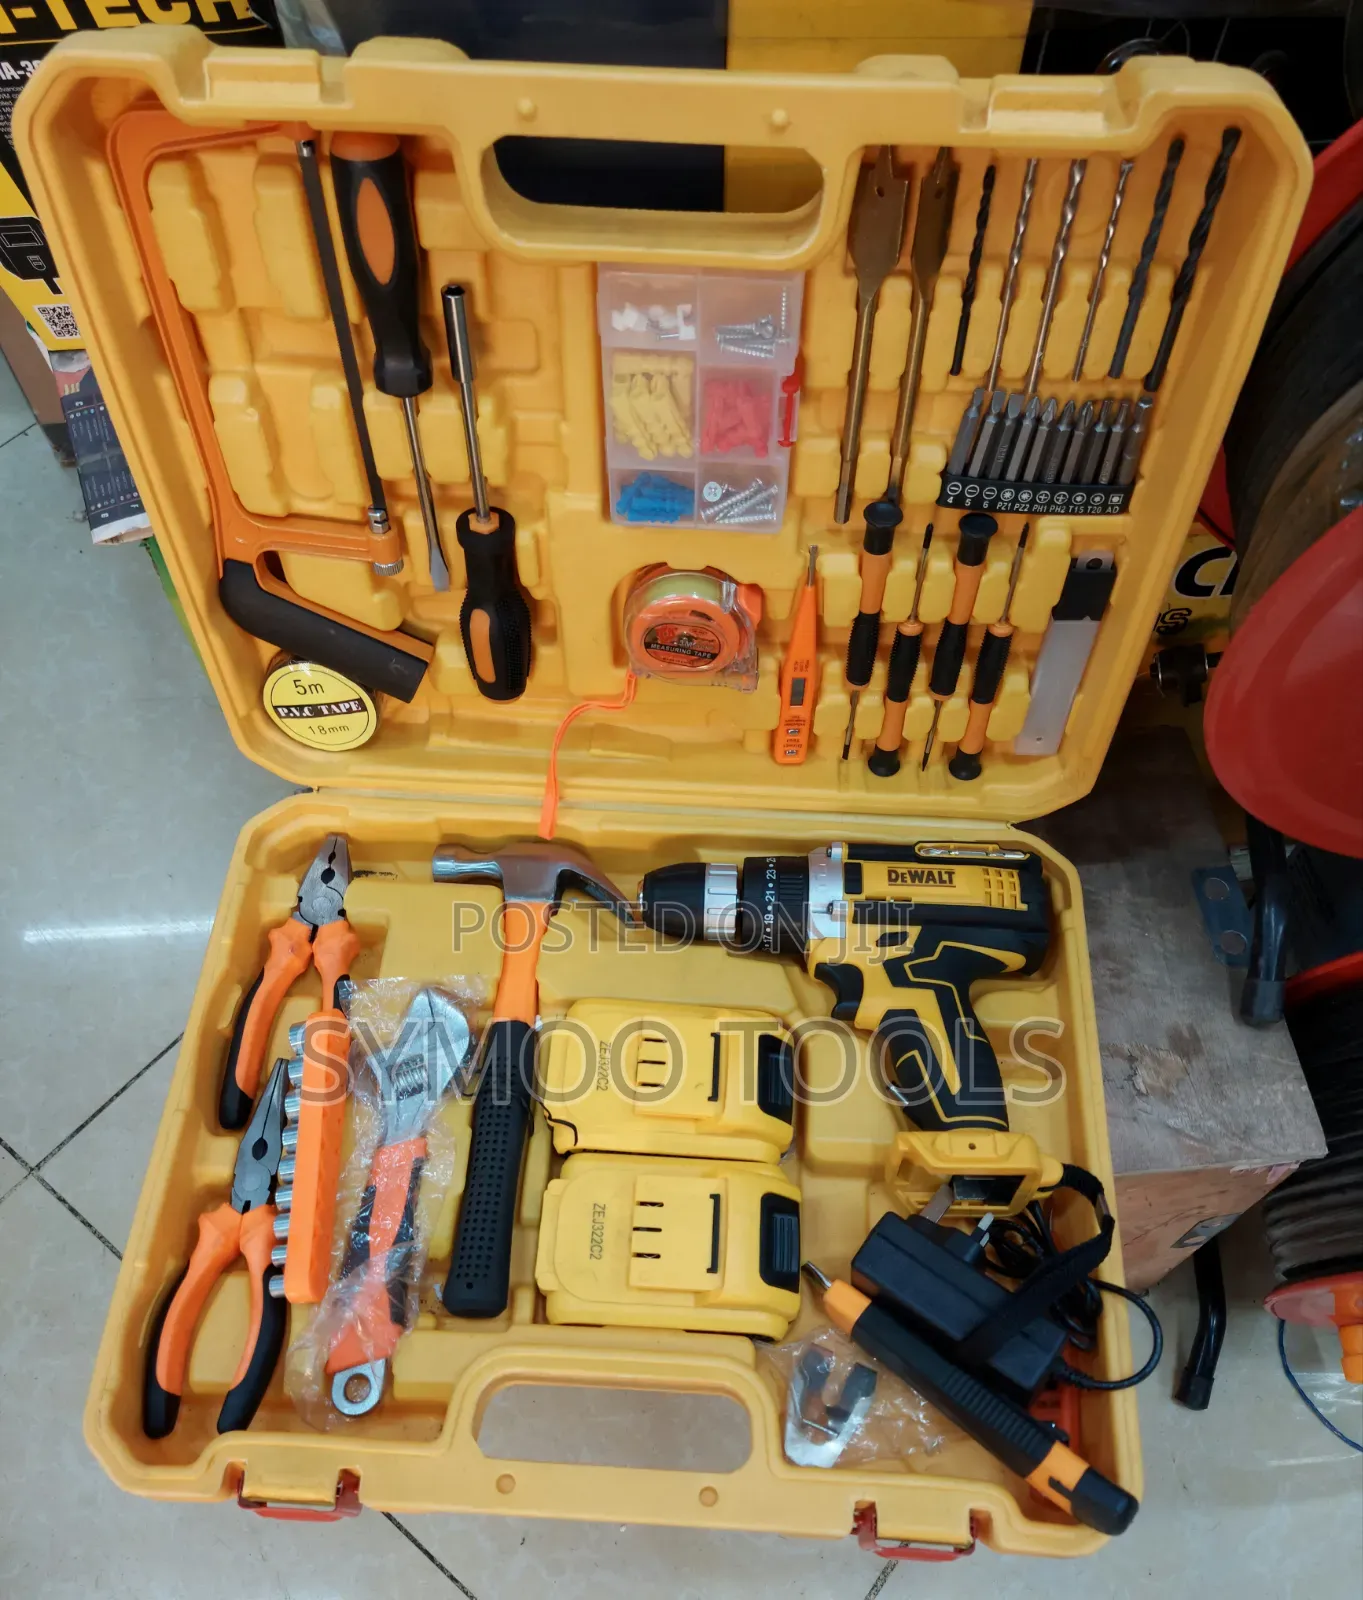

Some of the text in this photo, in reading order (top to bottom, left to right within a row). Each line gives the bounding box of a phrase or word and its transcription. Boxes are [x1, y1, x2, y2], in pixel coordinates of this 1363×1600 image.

[947, 496, 1120, 514] 4 5 6 PZ1 PZ2 PH1 PH2 T15 T20 AD
[650, 643, 692, 655] MEASURING
[694, 651, 712, 659] TAPE
[293, 679, 325, 696] 5m
[276, 700, 362, 717] P.V.C TAPE
[766, 869, 777, 880] 23
[765, 890, 776, 902] 21
[764, 913, 774, 925] 19
[589, 1202, 606, 1261] ZEJ322C2
